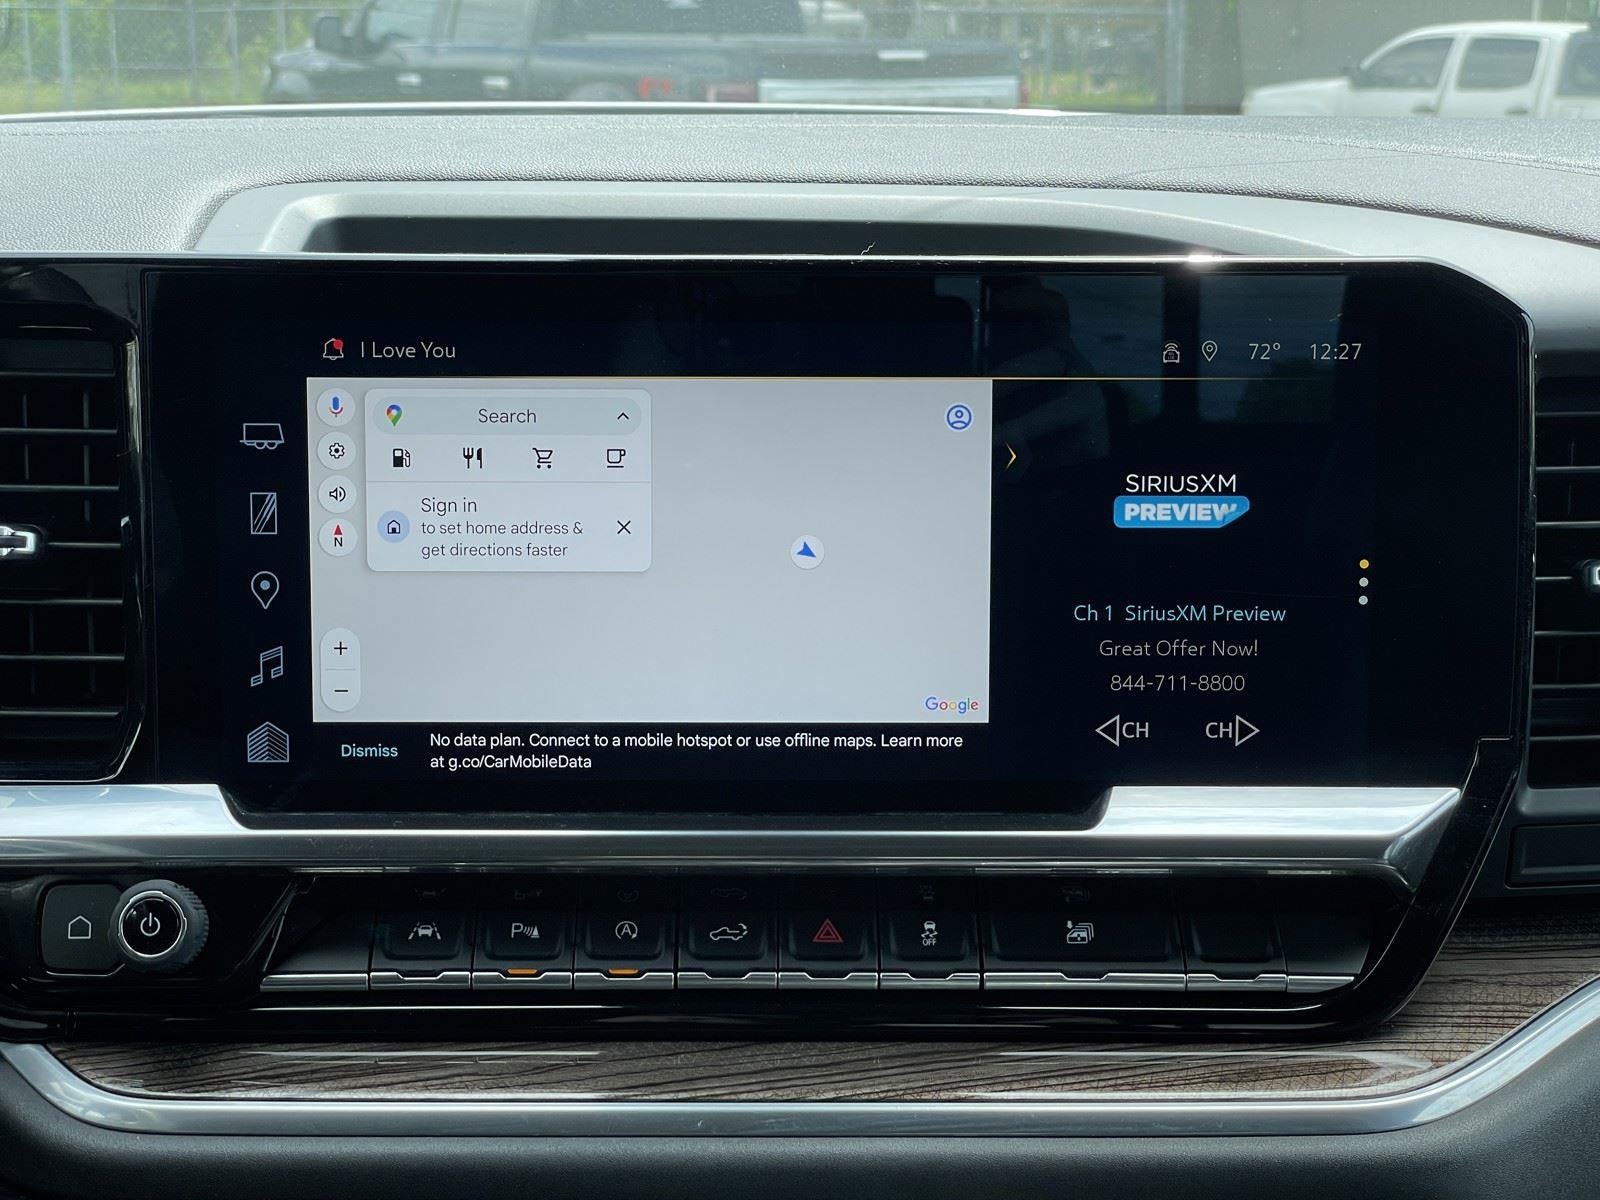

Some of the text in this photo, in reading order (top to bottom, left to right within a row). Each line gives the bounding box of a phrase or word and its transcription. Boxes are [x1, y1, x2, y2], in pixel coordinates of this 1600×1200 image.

[360, 341, 457, 358] I Love You
[1248, 342, 1362, 360] 72° 12:27
[477, 407, 538, 424] Search
[1125, 473, 1238, 493] SIRIUSXM
[420, 496, 478, 517] Sign in
[1124, 503, 1238, 521] PREVIEW
[420, 520, 584, 535] to set home address &
[333, 537, 343, 548] N
[420, 542, 569, 560] get directions faster
[1073, 604, 1287, 622] Ch 1 SiriusXM Preview
[1098, 639, 1259, 657] Great Offer Now!
[1110, 674, 1246, 692] 844-711-8800
[924, 696, 980, 714] Google
[1122, 722, 1150, 739] CH
[1205, 722, 1233, 739] CH
[340, 743, 399, 758] Dismiss
[430, 733, 963, 751] No data plan. Connect to a mobile hotspot or use offline maps. Learn more
[430, 753, 592, 772] at g.co/CarMobileData
[922, 938, 937, 946] OFF
